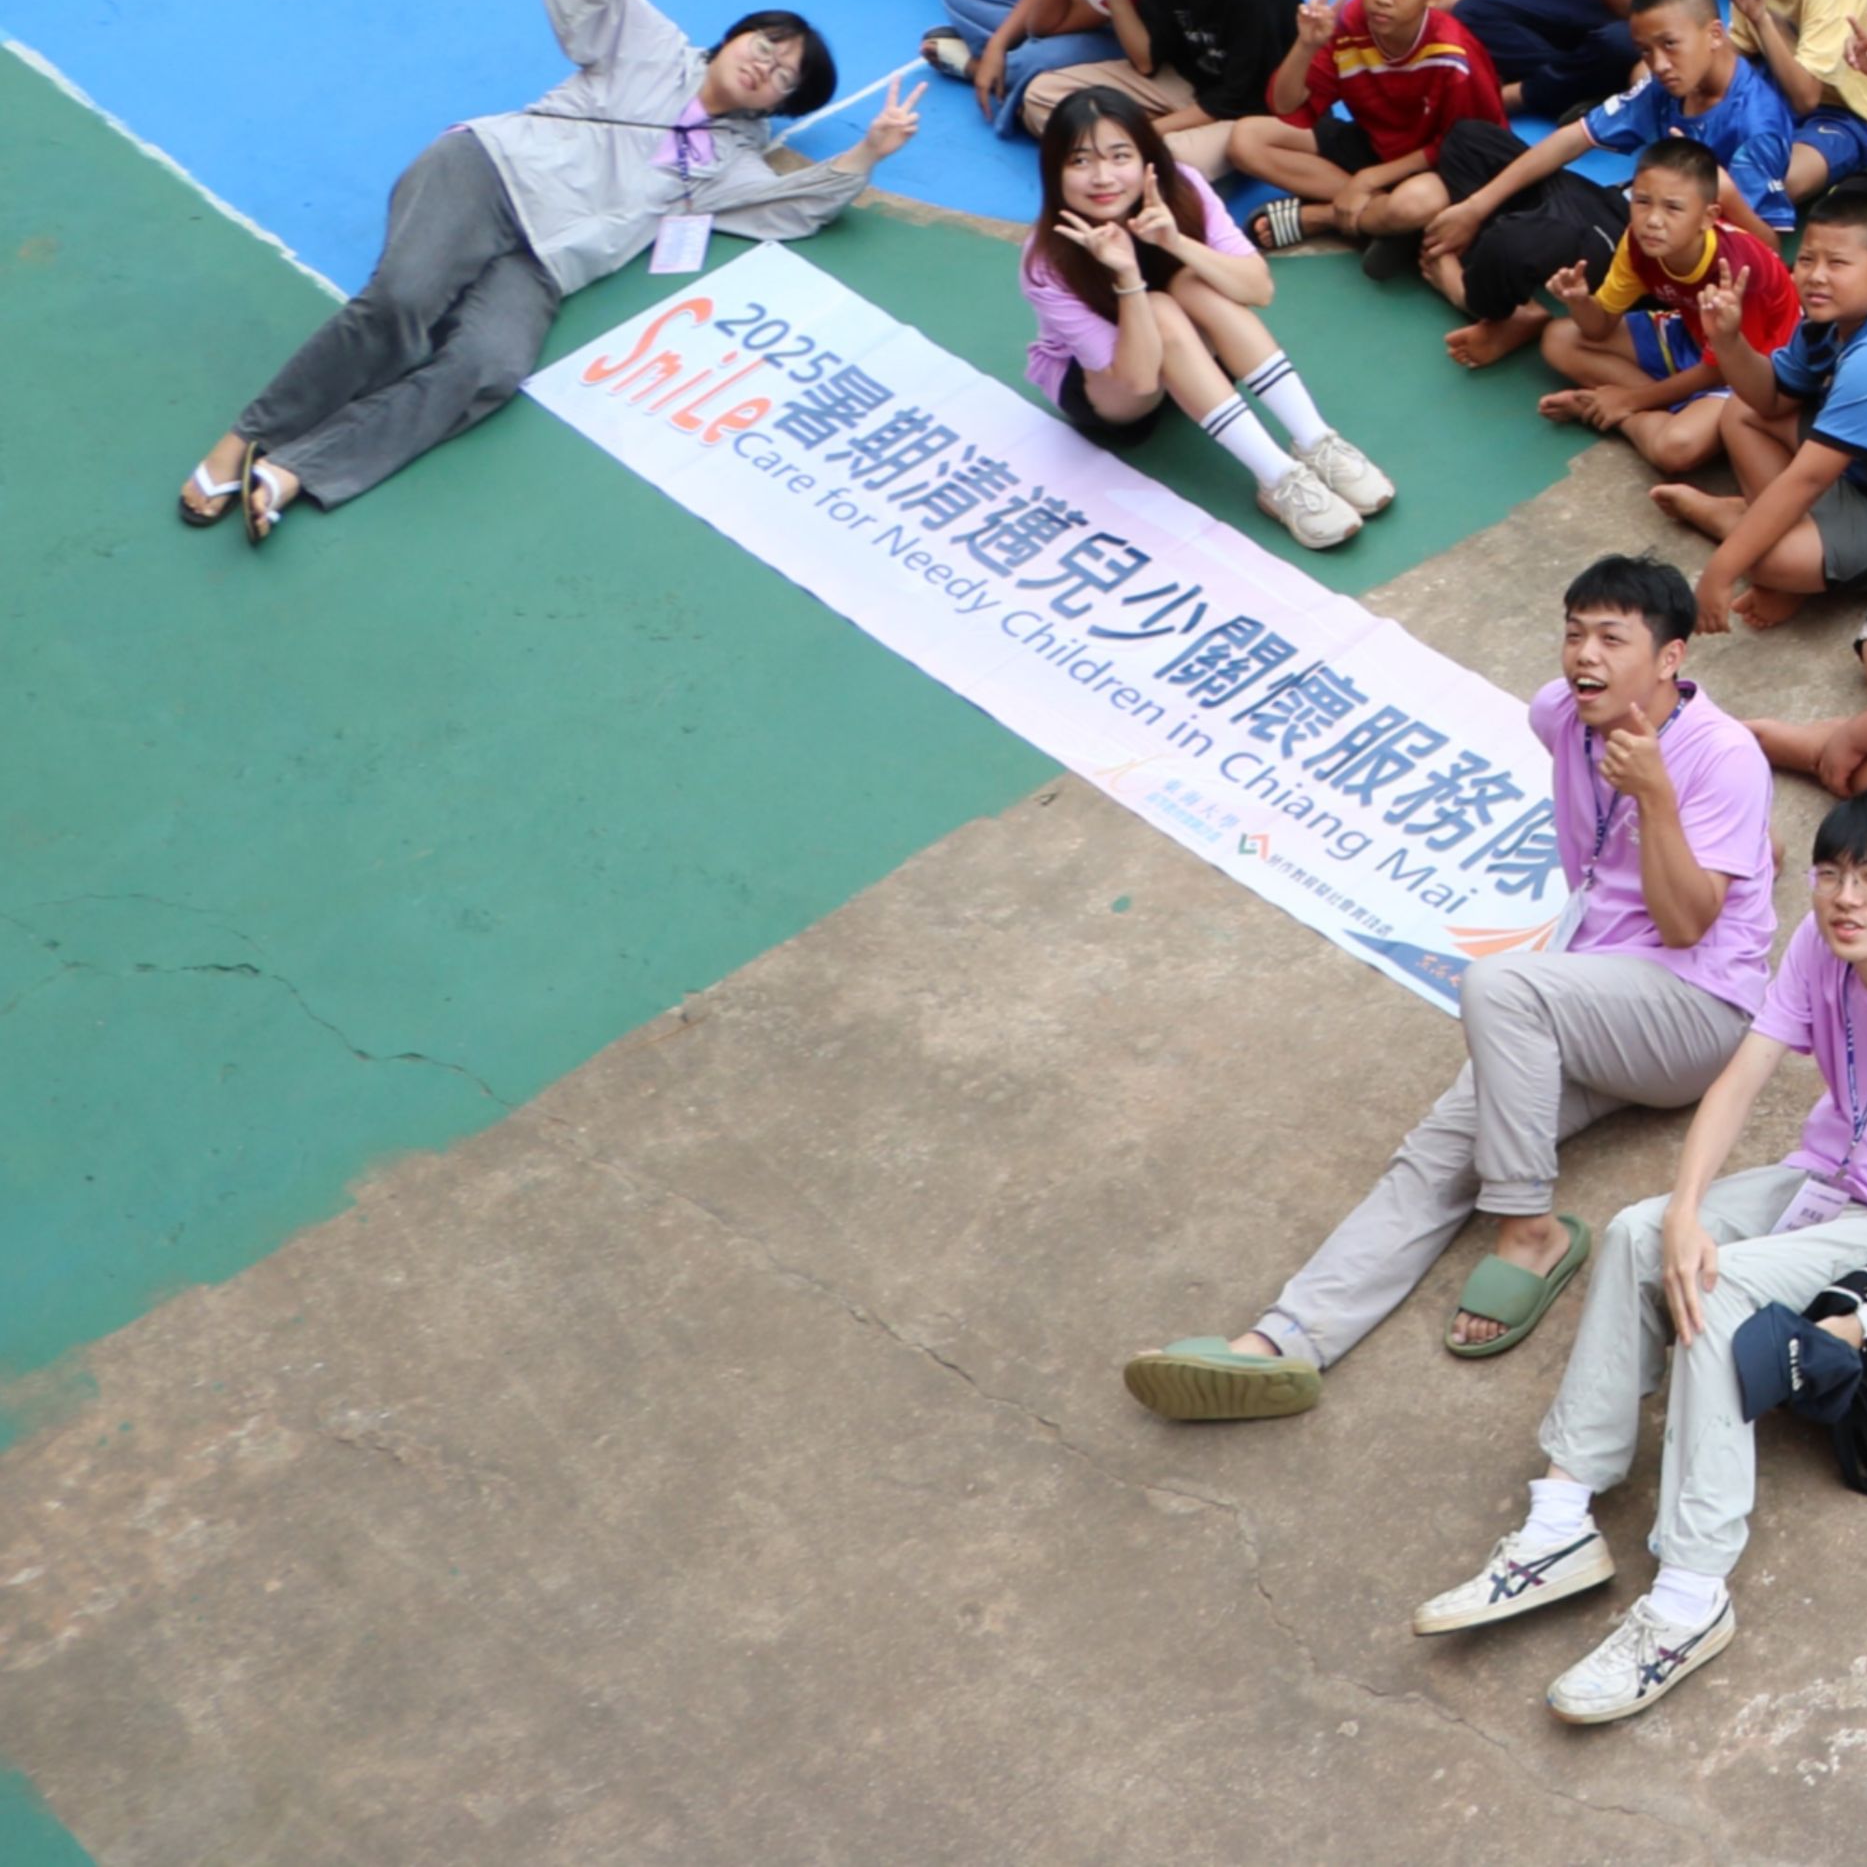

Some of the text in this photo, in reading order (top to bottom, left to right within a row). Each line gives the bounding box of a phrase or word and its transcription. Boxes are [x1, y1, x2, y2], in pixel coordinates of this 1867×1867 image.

[733, 431, 816, 495] Care
[813, 487, 878, 530] for
[871, 524, 1002, 614] Needy
[1001, 610, 1166, 726] Children
[1166, 714, 1214, 758] in
[1219, 751, 1374, 861] Chiang
[1375, 847, 1479, 915] Mai
